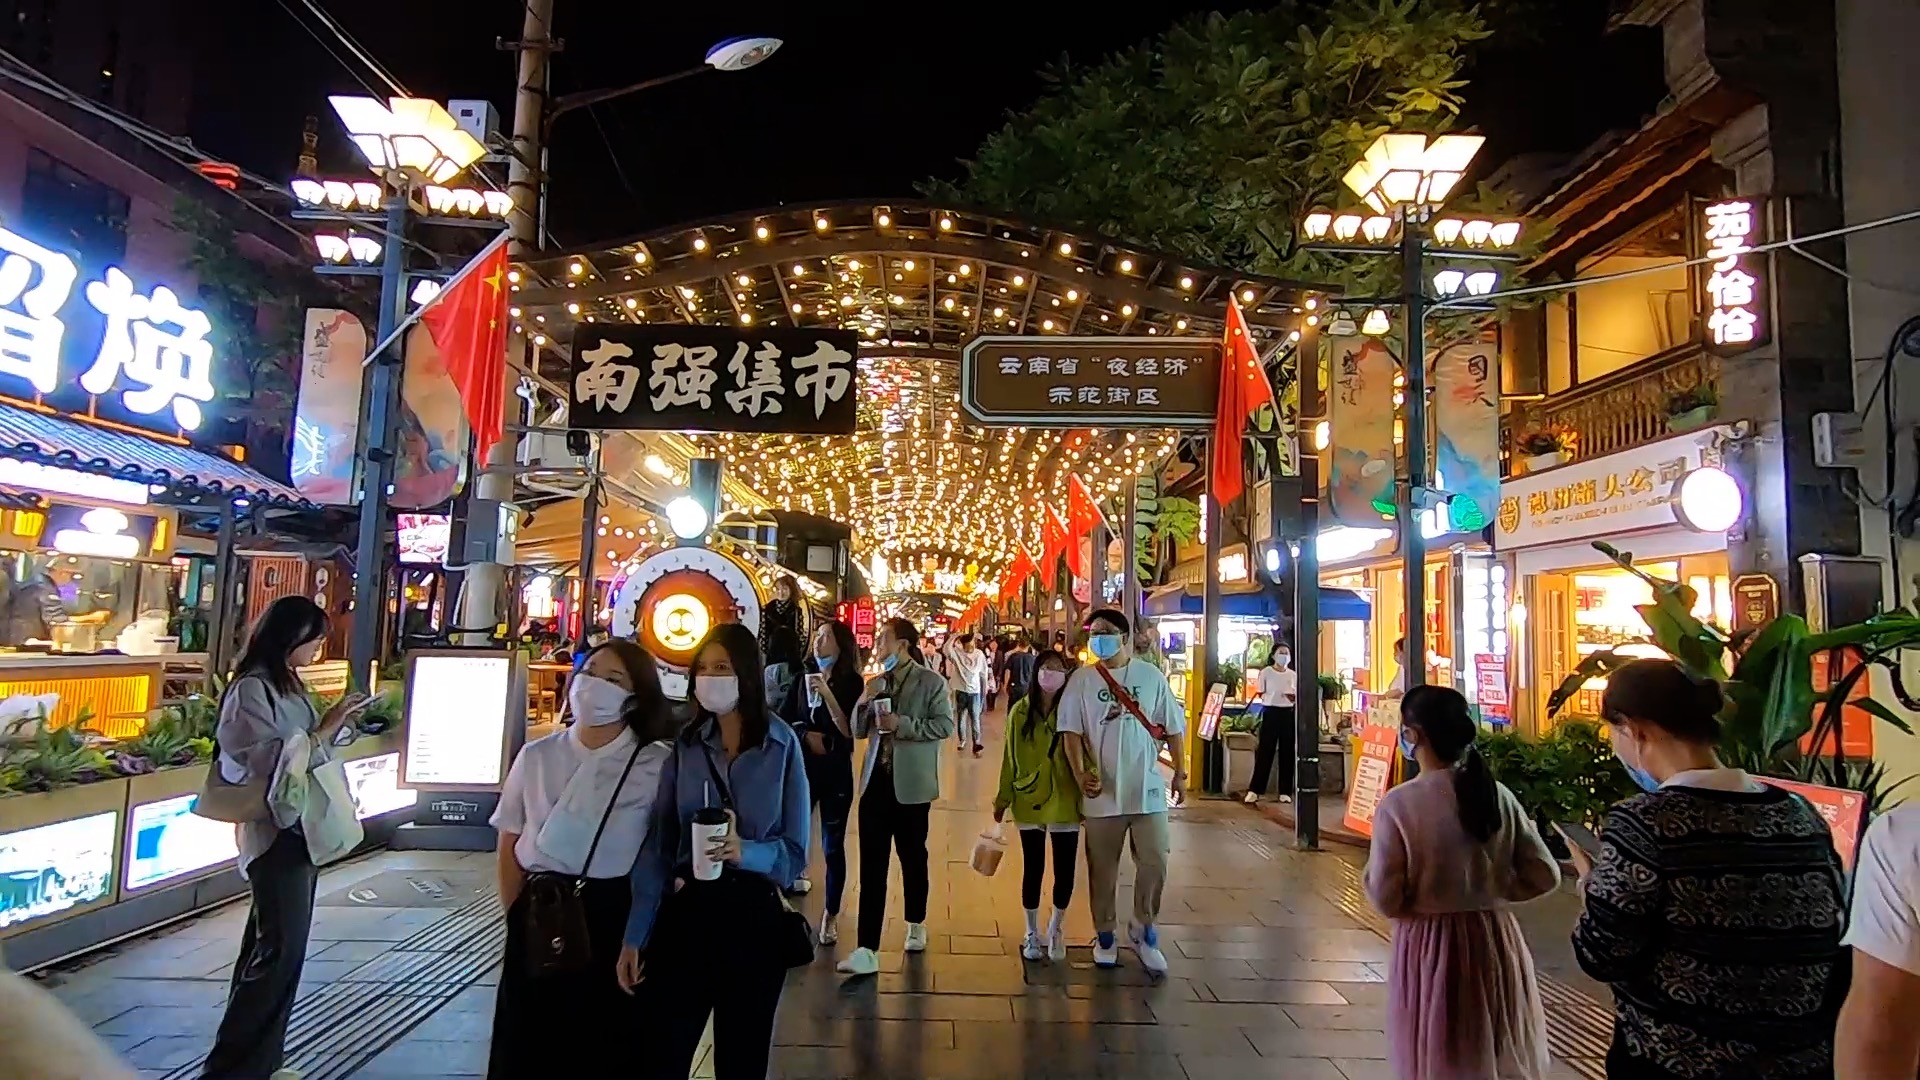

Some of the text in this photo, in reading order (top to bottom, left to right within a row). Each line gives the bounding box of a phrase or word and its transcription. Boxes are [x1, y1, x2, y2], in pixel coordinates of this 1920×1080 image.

[1705, 201, 1757, 345] 茄子恰恰
[575, 338, 852, 421] 南强集市
[1048, 386, 1161, 405] 示范街区
